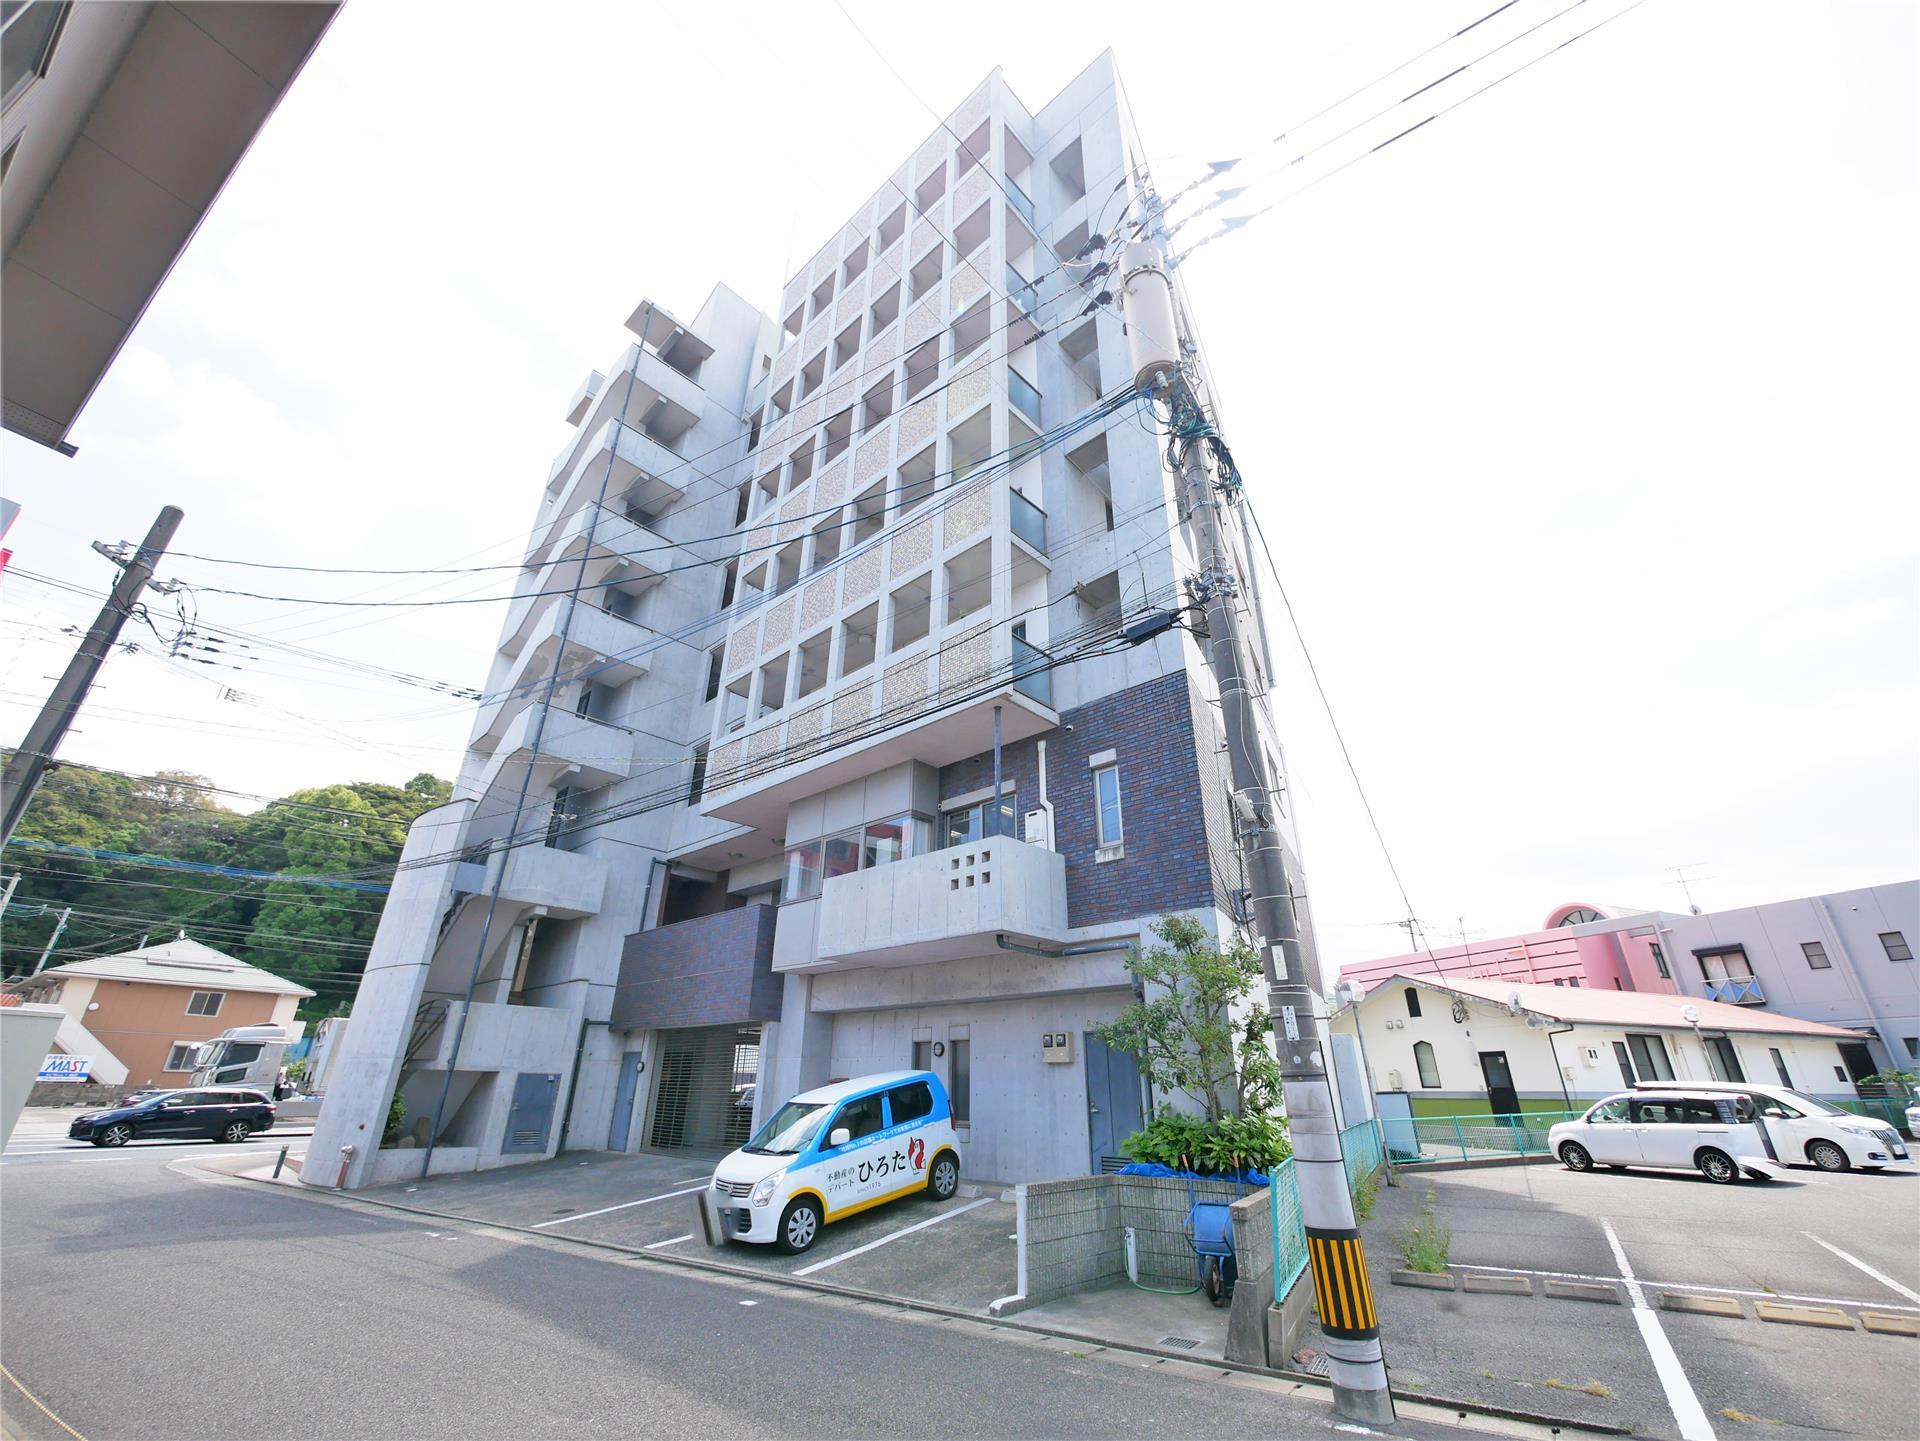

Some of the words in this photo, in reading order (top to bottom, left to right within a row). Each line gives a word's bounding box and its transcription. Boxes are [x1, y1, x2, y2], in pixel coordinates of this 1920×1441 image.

[45, 1060, 88, 1072] MAST
[858, 1150, 906, 1182] ひろた
[827, 1167, 855, 1182] 不動産の
[828, 1179, 855, 1193] デパート
